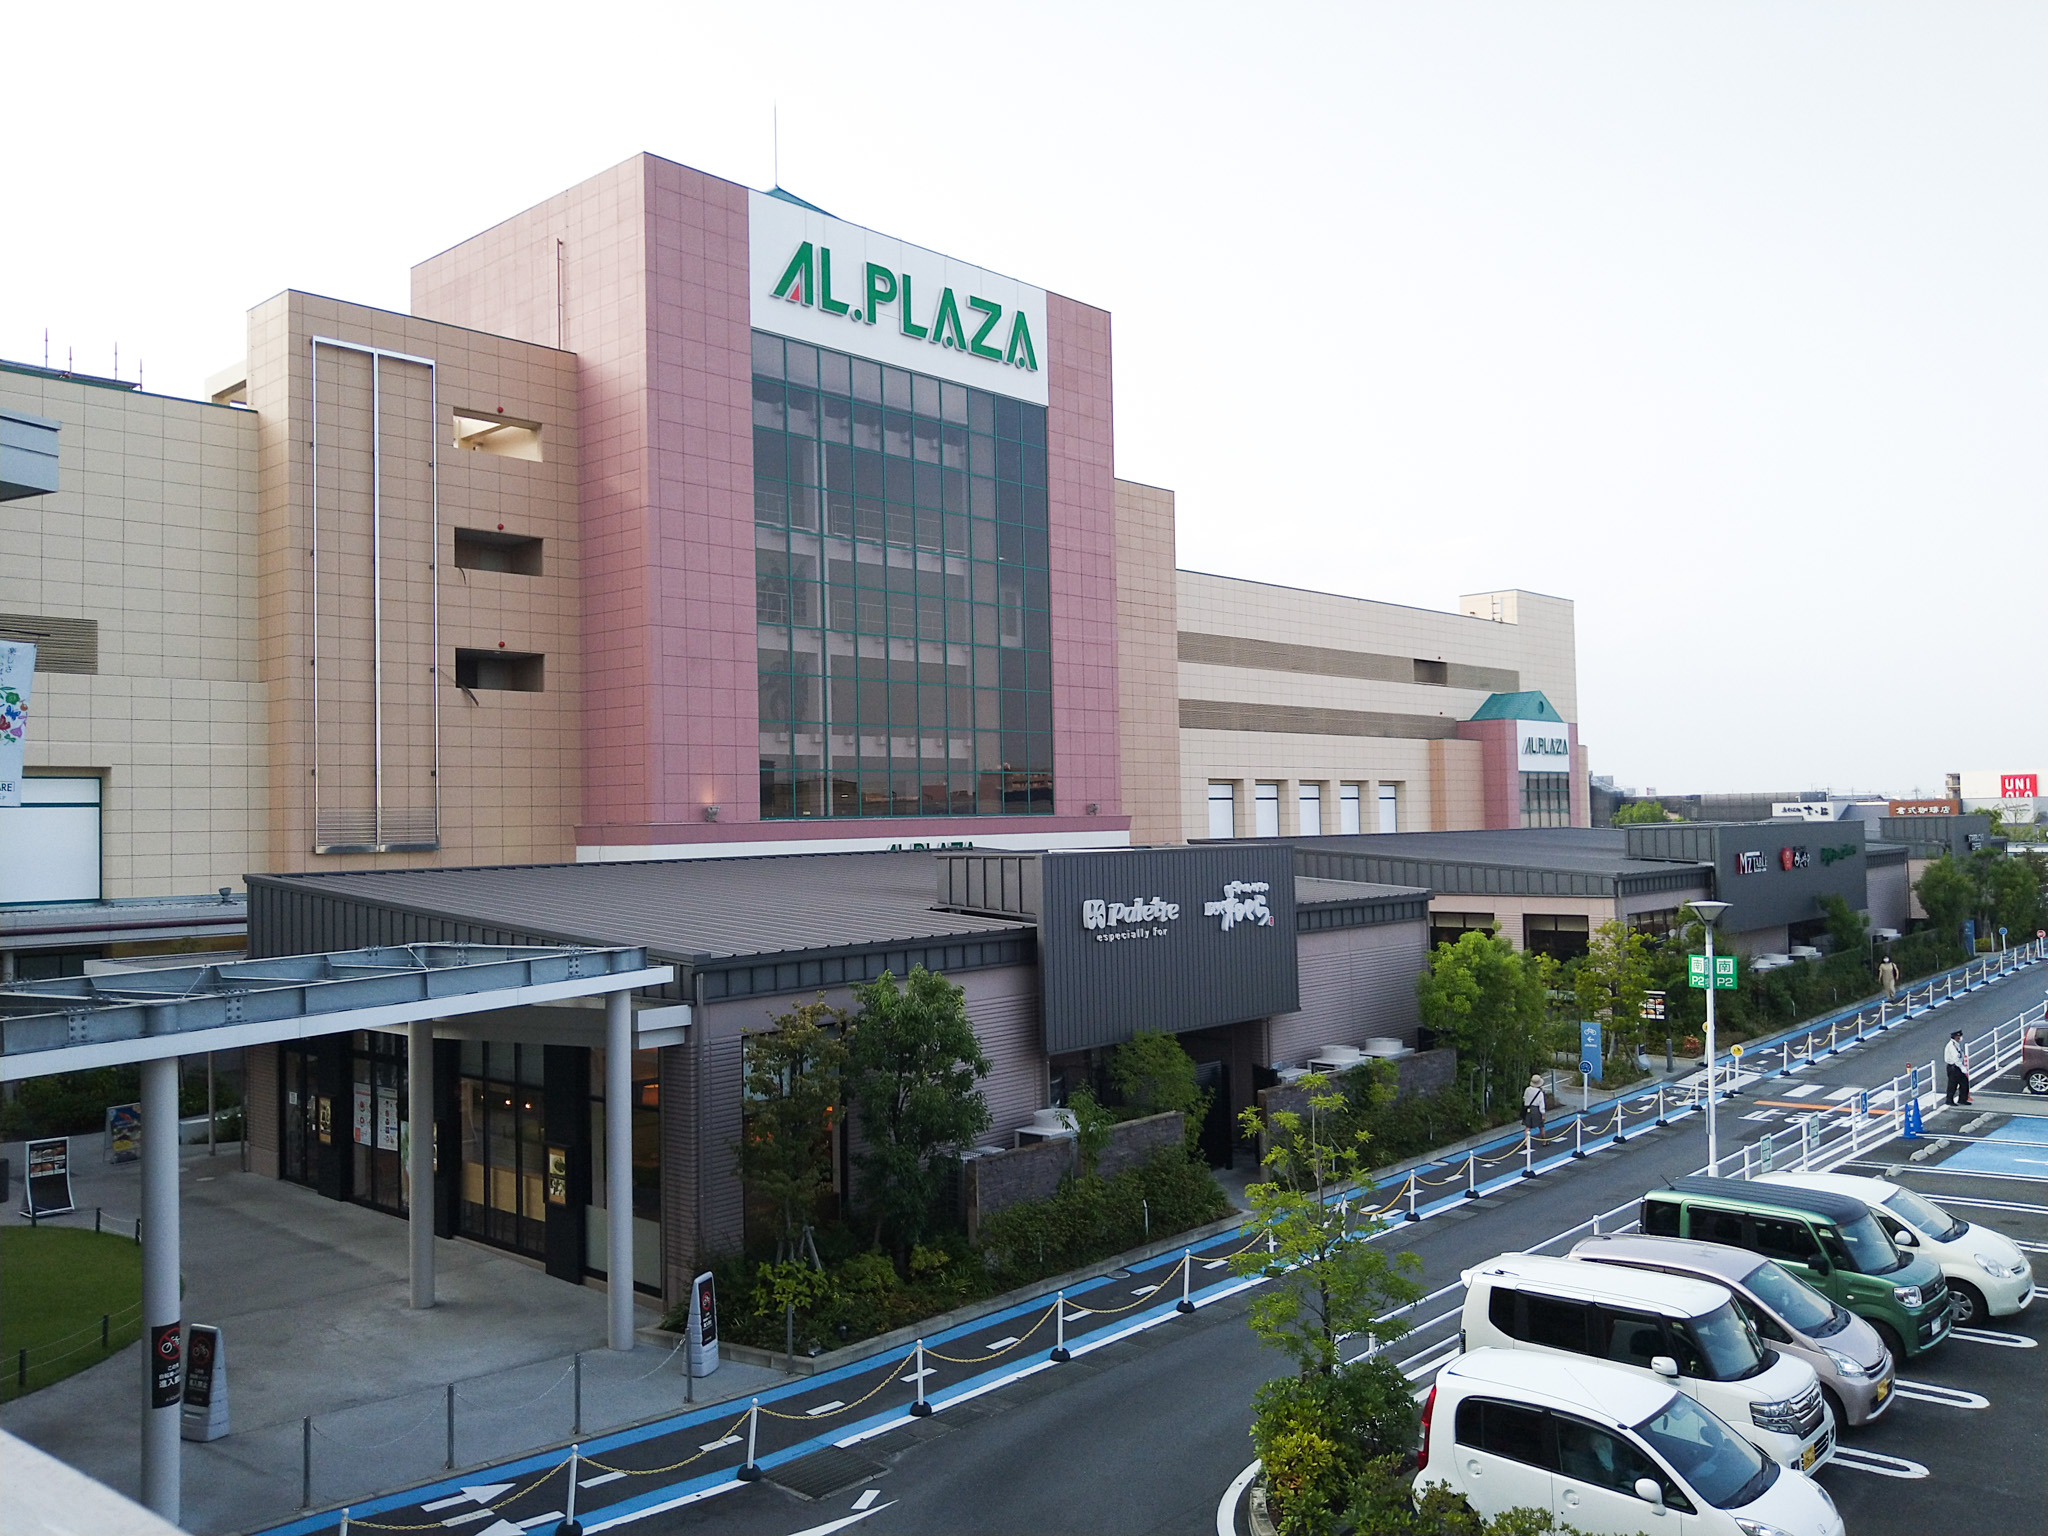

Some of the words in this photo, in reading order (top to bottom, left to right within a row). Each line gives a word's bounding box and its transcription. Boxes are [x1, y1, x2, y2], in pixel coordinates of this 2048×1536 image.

[770, 241, 1038, 372] AL.PLAZA
[0, 783, 13, 792] RE
[2004, 777, 2030, 790] UNI
[1096, 928, 1150, 943] especially
[1152, 926, 1168, 937] for
[1692, 959, 1703, 972] 南
[1717, 960, 1732, 973] 南
[1691, 975, 1704, 986] P2
[1716, 977, 1733, 987] P2
